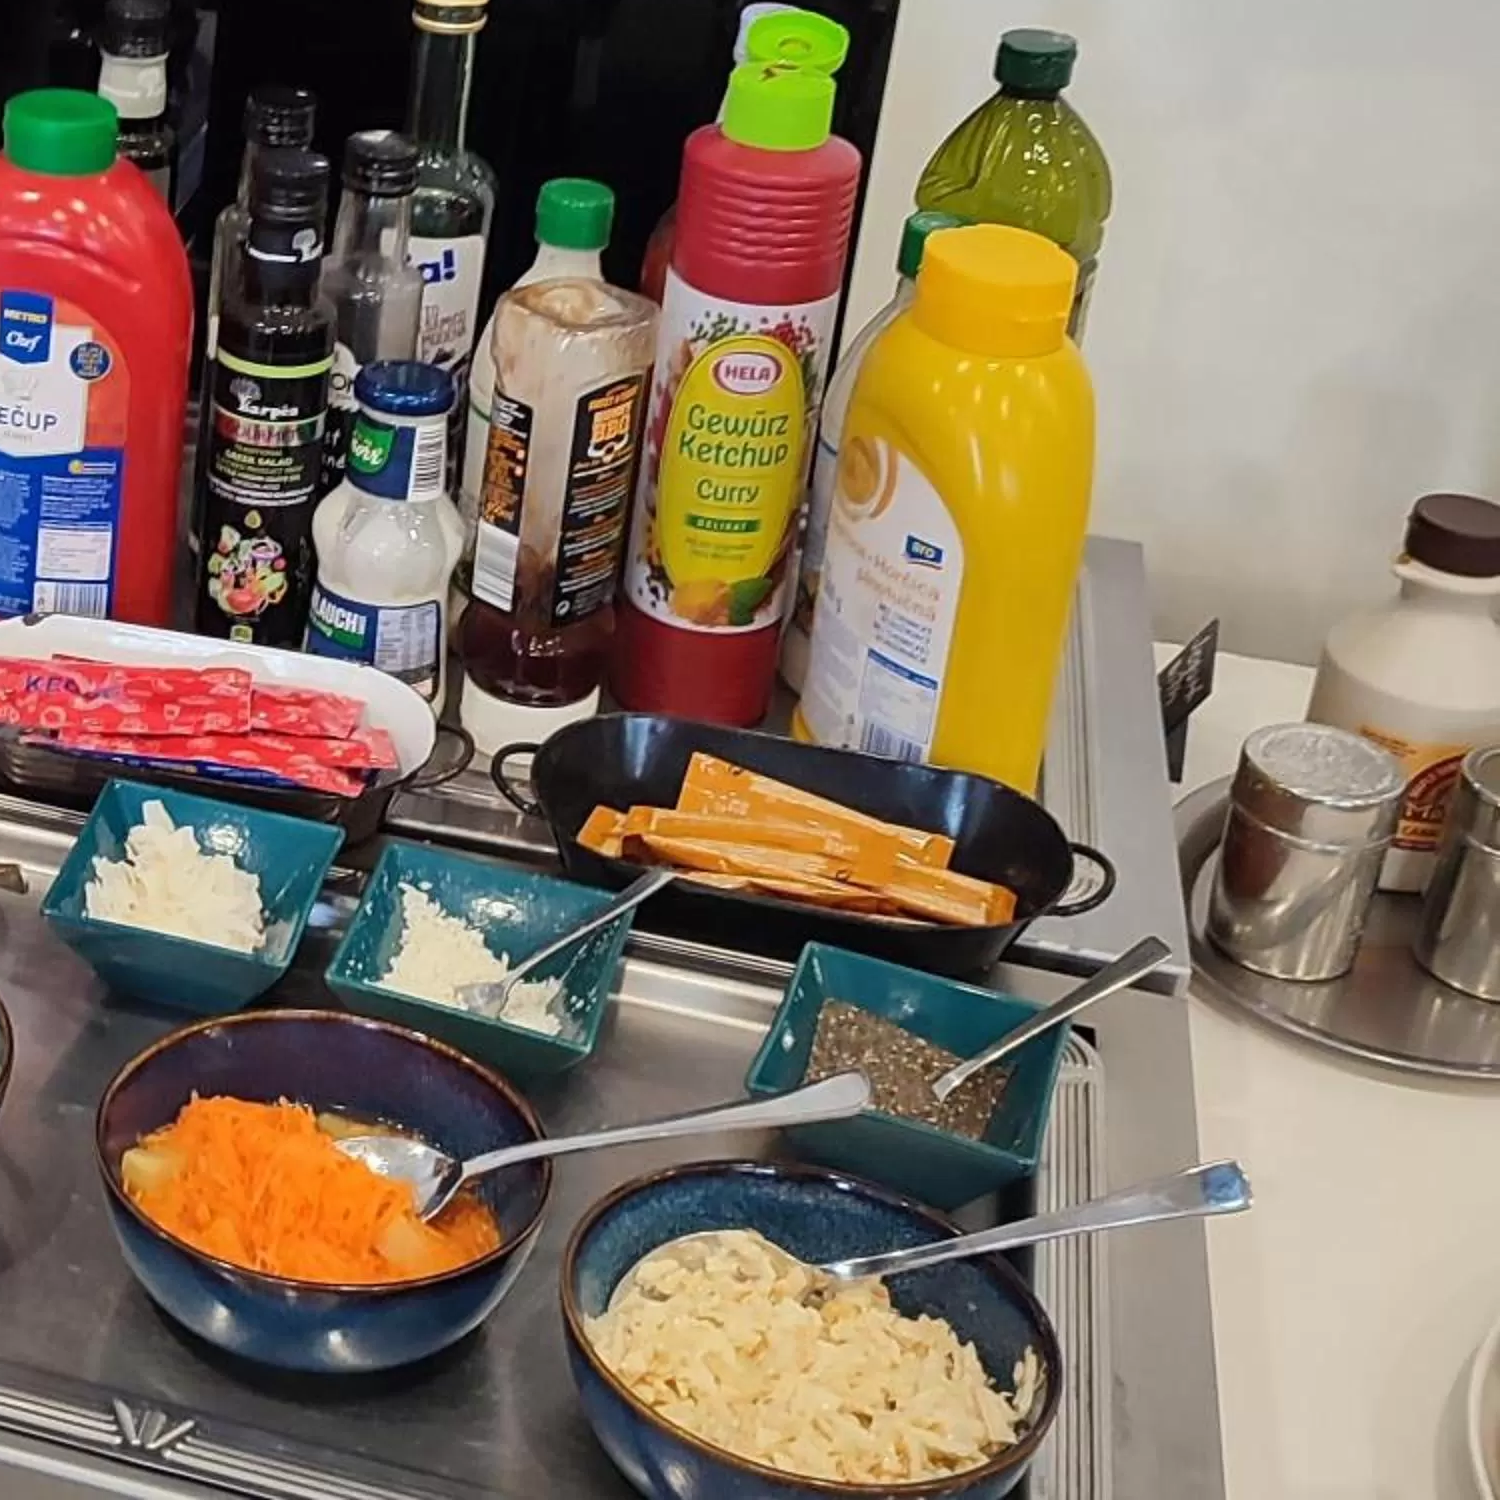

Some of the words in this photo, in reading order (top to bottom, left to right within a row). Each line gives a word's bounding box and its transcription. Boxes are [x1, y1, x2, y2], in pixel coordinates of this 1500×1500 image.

[5, 330, 42, 352] Chef
[724, 364, 771, 381] HELA
[687, 403, 789, 438] Gewürz
[679, 430, 789, 468] Ketchup
[696, 478, 760, 503] Curry
